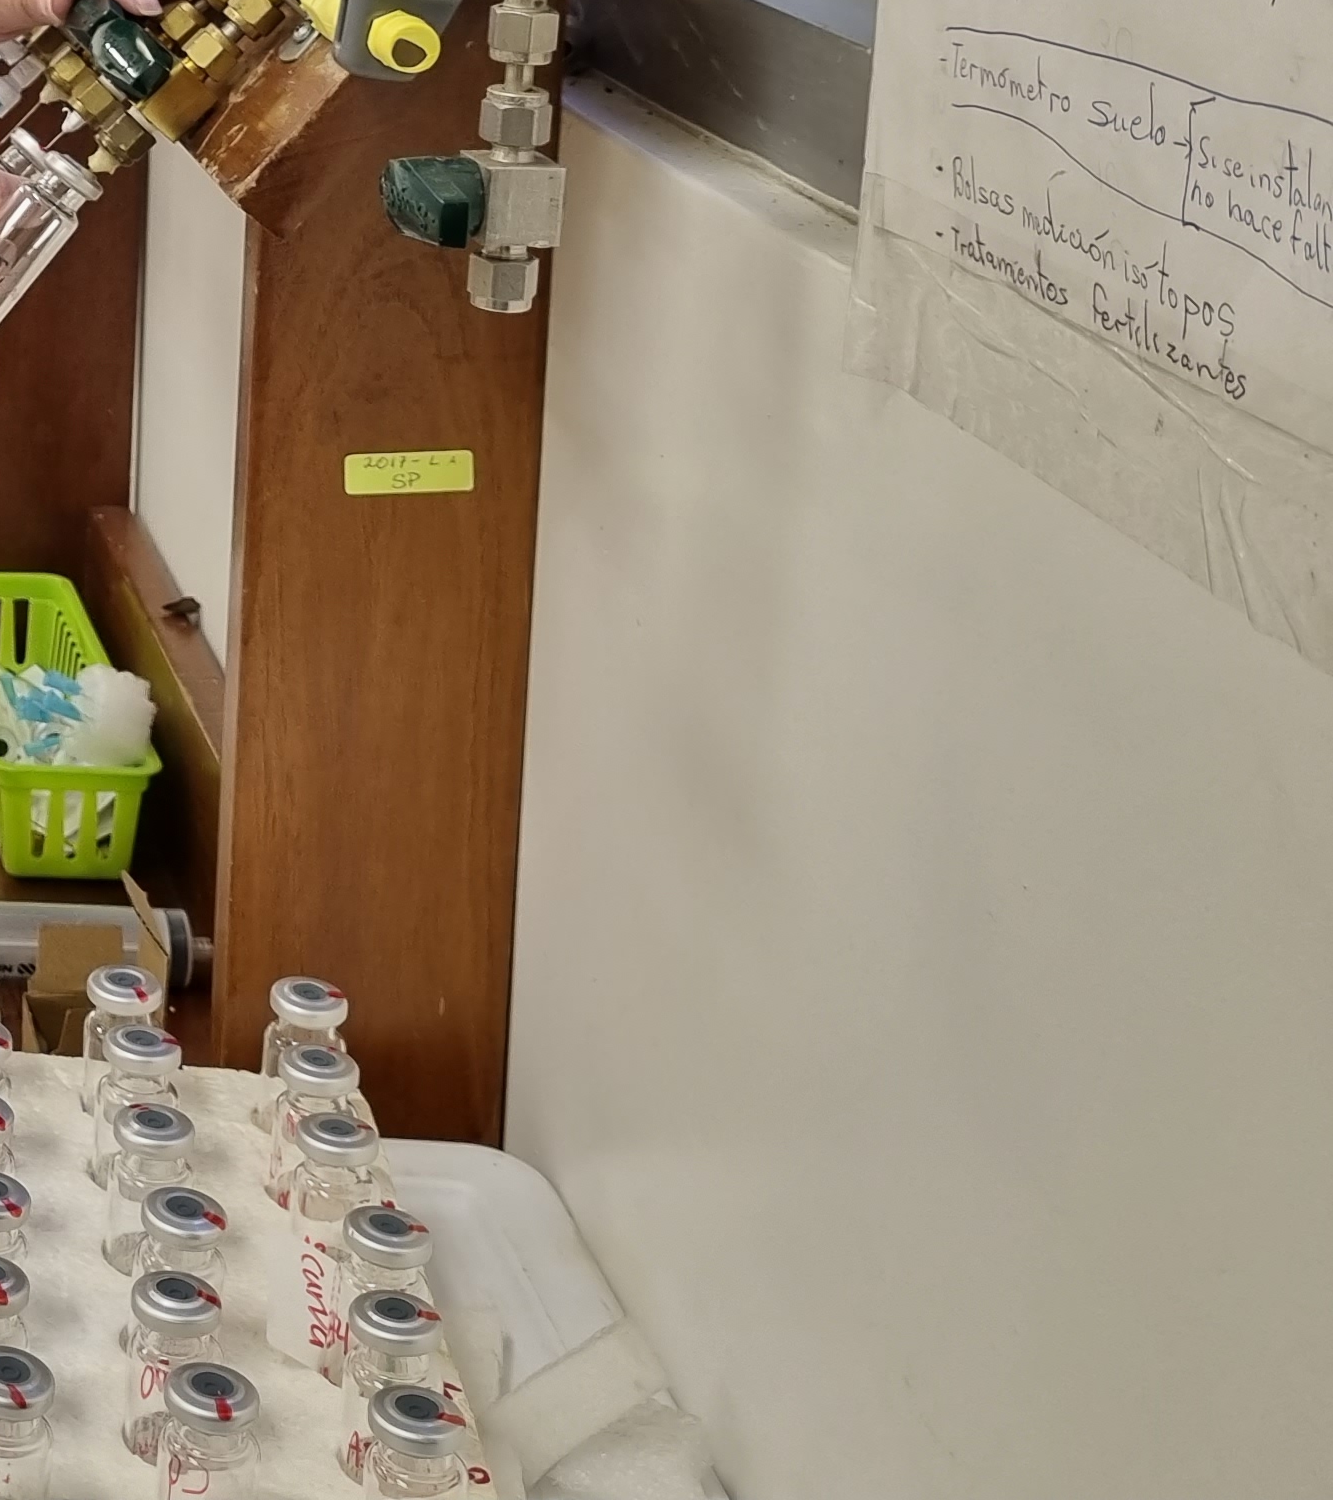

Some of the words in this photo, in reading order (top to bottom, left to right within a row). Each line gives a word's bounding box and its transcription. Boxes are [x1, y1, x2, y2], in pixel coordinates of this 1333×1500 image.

[951, 155, 1015, 215] Bolsas
[1021, 186, 1116, 271] medición
[1123, 240, 1236, 340] isótopos
[1191, 179, 1215, 208] no
[1227, 189, 1283, 244] hace
[950, 223, 1070, 307] Tratamientos
[1091, 282, 1247, 401] fertilizantes
[391, 472, 421, 488] SP
